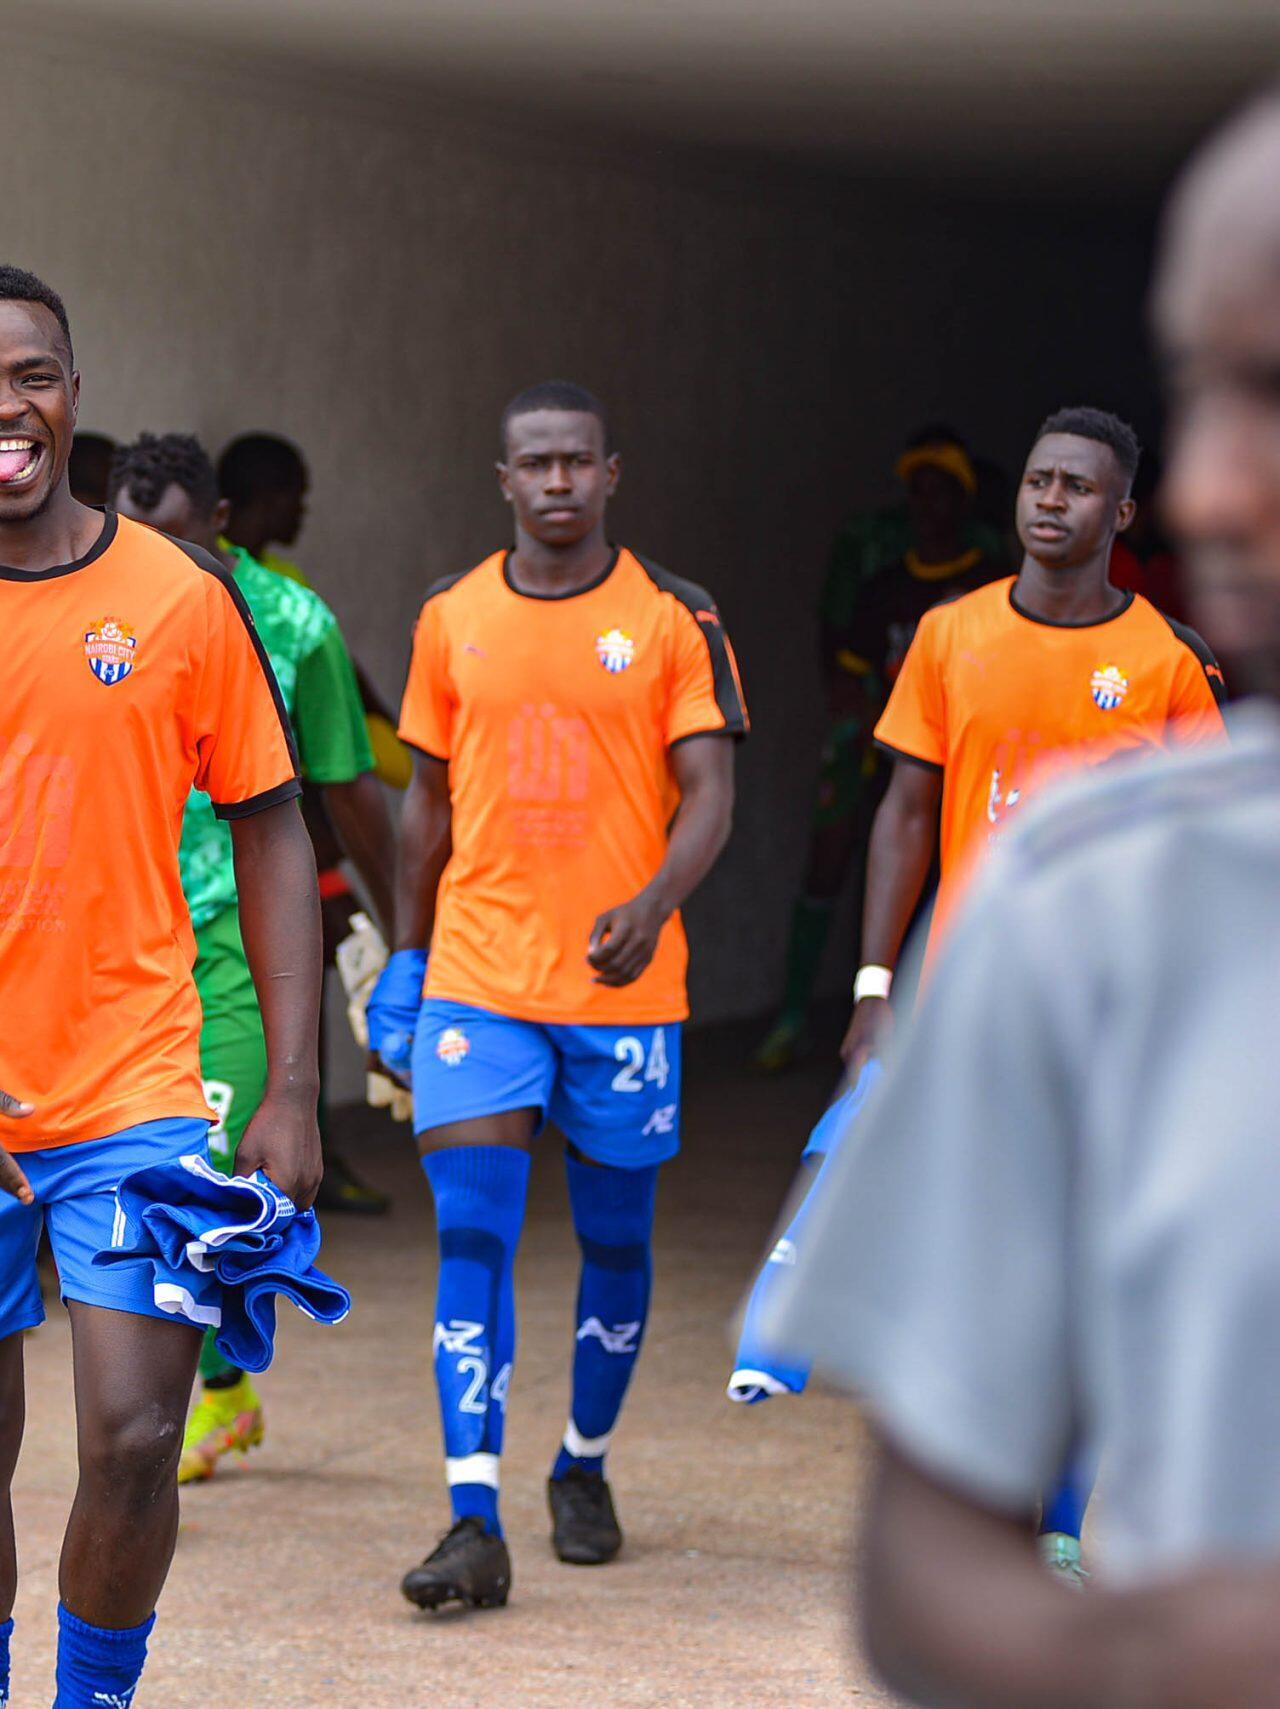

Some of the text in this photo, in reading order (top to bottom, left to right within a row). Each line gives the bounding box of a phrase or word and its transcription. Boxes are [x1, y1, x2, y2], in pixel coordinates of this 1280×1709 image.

[84, 643, 136, 660] NAIROBI CITY
[611, 1026, 670, 1090] 24
[456, 1356, 512, 1415] 24
